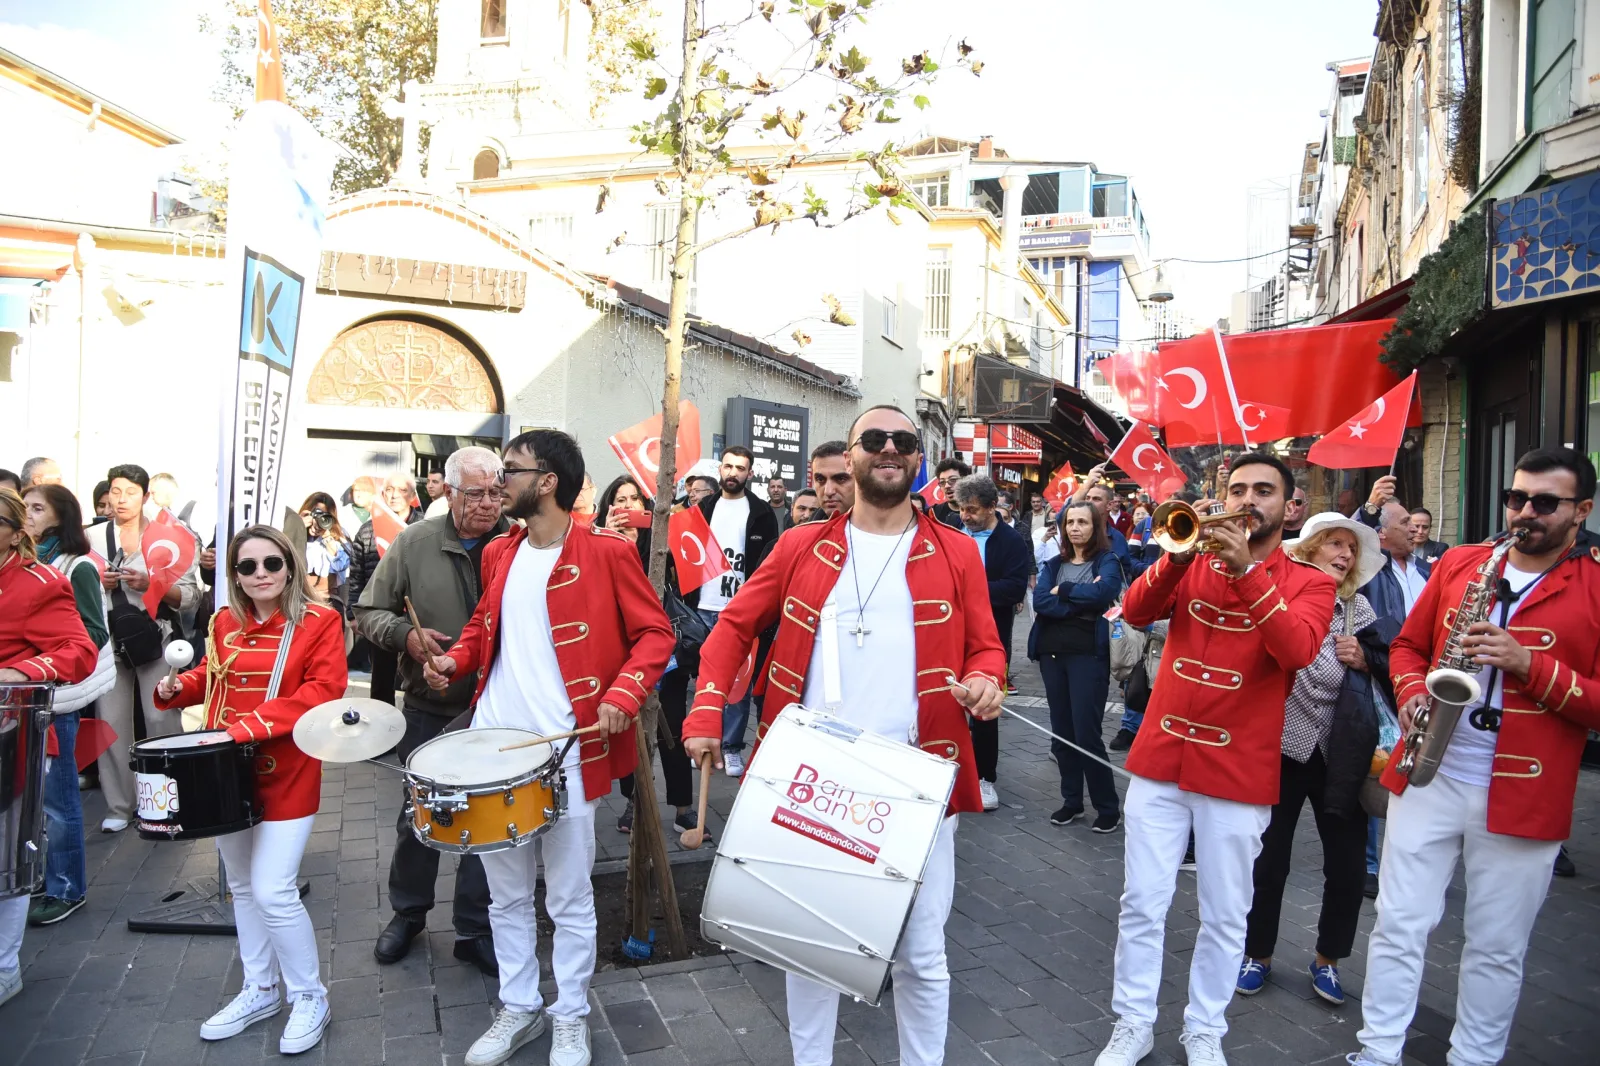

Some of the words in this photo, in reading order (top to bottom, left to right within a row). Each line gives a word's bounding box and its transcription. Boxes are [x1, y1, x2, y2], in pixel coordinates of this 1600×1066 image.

[753, 414, 767, 427] THE
[778, 418, 801, 432] SOUND
[753, 425, 763, 437] OF
[763, 427, 800, 442] SUPERSTAR
[264, 390, 283, 512] KADIKÖY
[776, 812, 875, 860] www.bandobando.com
